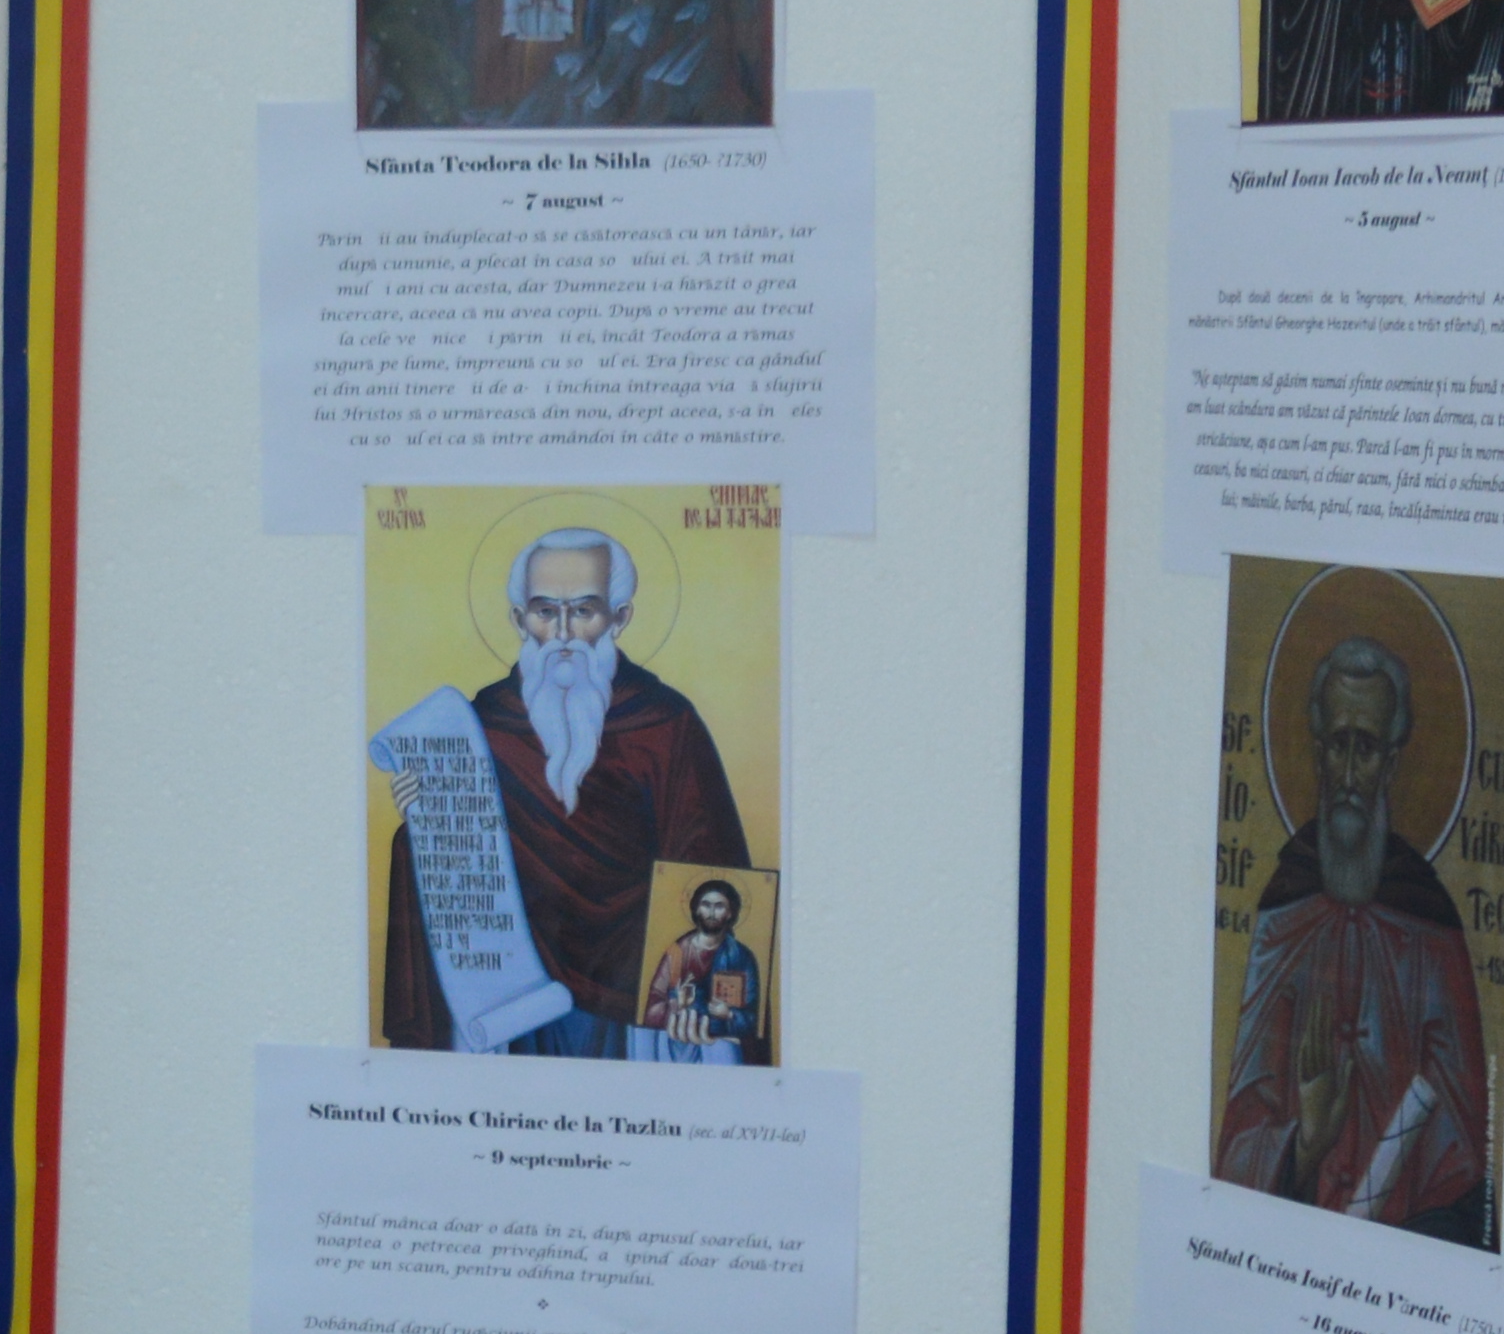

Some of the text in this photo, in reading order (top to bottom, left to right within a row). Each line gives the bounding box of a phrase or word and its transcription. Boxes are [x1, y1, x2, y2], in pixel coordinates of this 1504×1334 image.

[365, 157, 434, 174] Sfânta
[440, 154, 531, 173] Teodora
[537, 153, 562, 171] de
[568, 152, 587, 170] la
[594, 151, 650, 169] Sihla
[1229, 169, 1288, 193] Sfântul
[1291, 168, 1329, 187] Ioan
[1333, 166, 1380, 186] Iacob
[1383, 165, 1404, 185] de
[1406, 165, 1424, 184] la
[1426, 164, 1488, 187] Neamț
[526, 192, 603, 211] 7 august
[1357, 210, 1422, 231] 5 august
[309, 1103, 385, 1122] Sfântul
[391, 1107, 462, 1125] Cuvios
[468, 1110, 548, 1129] Chiriac
[553, 1114, 578, 1131] de
[584, 1115, 603, 1133] la
[608, 1116, 681, 1136] Tazlău
[720, 1125, 734, 1139] al
[491, 1149, 612, 1170] 9 septembrie
[314, 1256, 654, 1288] ore pe un scaun, pentru odihna trupului.
[1187, 1237, 1244, 1267] Sfântul
[1246, 1253, 1298, 1283] Cuvios
[1300, 1269, 1343, 1298] Iosif
[1341, 1280, 1362, 1299] de
[1364, 1285, 1382, 1306] la
[1312, 1314, 1331, 1332] 16
